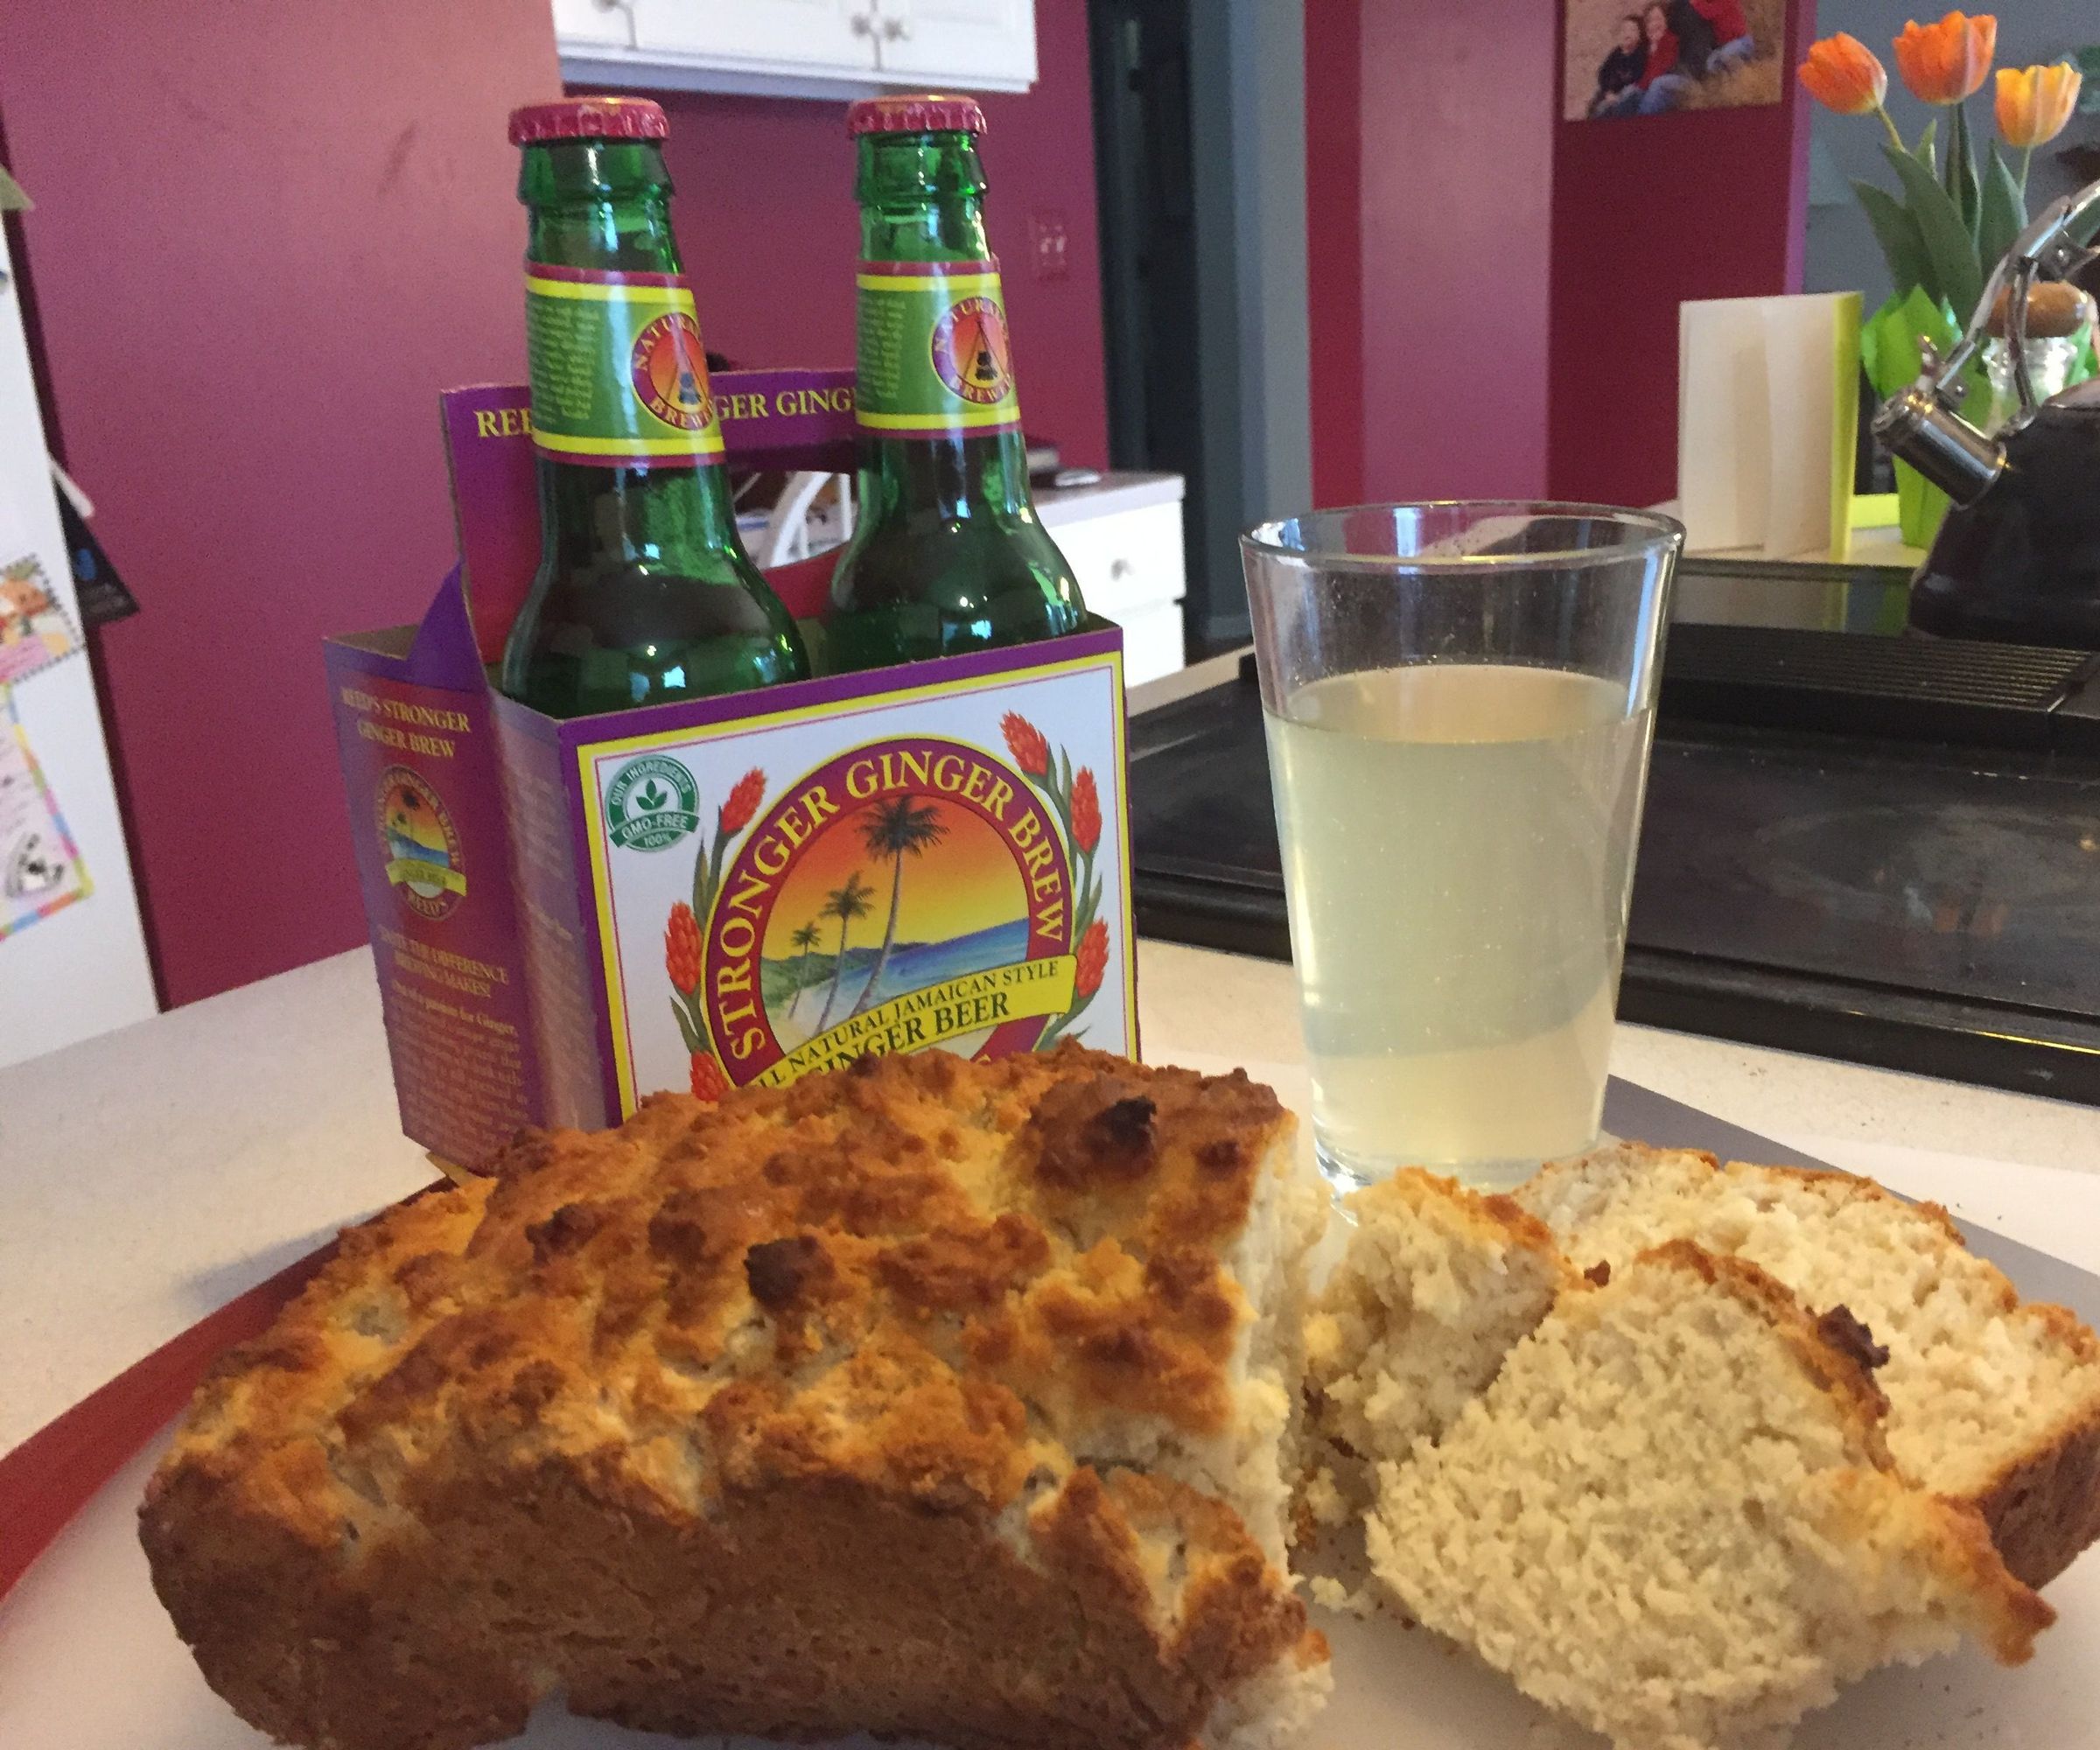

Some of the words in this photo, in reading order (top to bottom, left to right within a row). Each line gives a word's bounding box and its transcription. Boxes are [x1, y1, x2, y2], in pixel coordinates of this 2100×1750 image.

[714, 394, 769, 421] GER
[776, 387, 856, 416] GING
[382, 700, 472, 732] STRONGER
[357, 718, 407, 750] GINGER
[408, 732, 455, 758] BREW
[611, 780, 628, 806] OUR
[620, 813, 690, 839] GMO-FREE
[643, 833, 674, 848] 100%
[717, 785, 840, 1060] STRONGER
[846, 750, 1014, 822] GINGER
[1008, 807, 1064, 942] BREW
[788, 1010, 889, 1072] NATURAL
[894, 972, 997, 1020] JAMAICAN
[1002, 960, 1059, 987] STYLE
[934, 990, 1010, 1036] BEER
